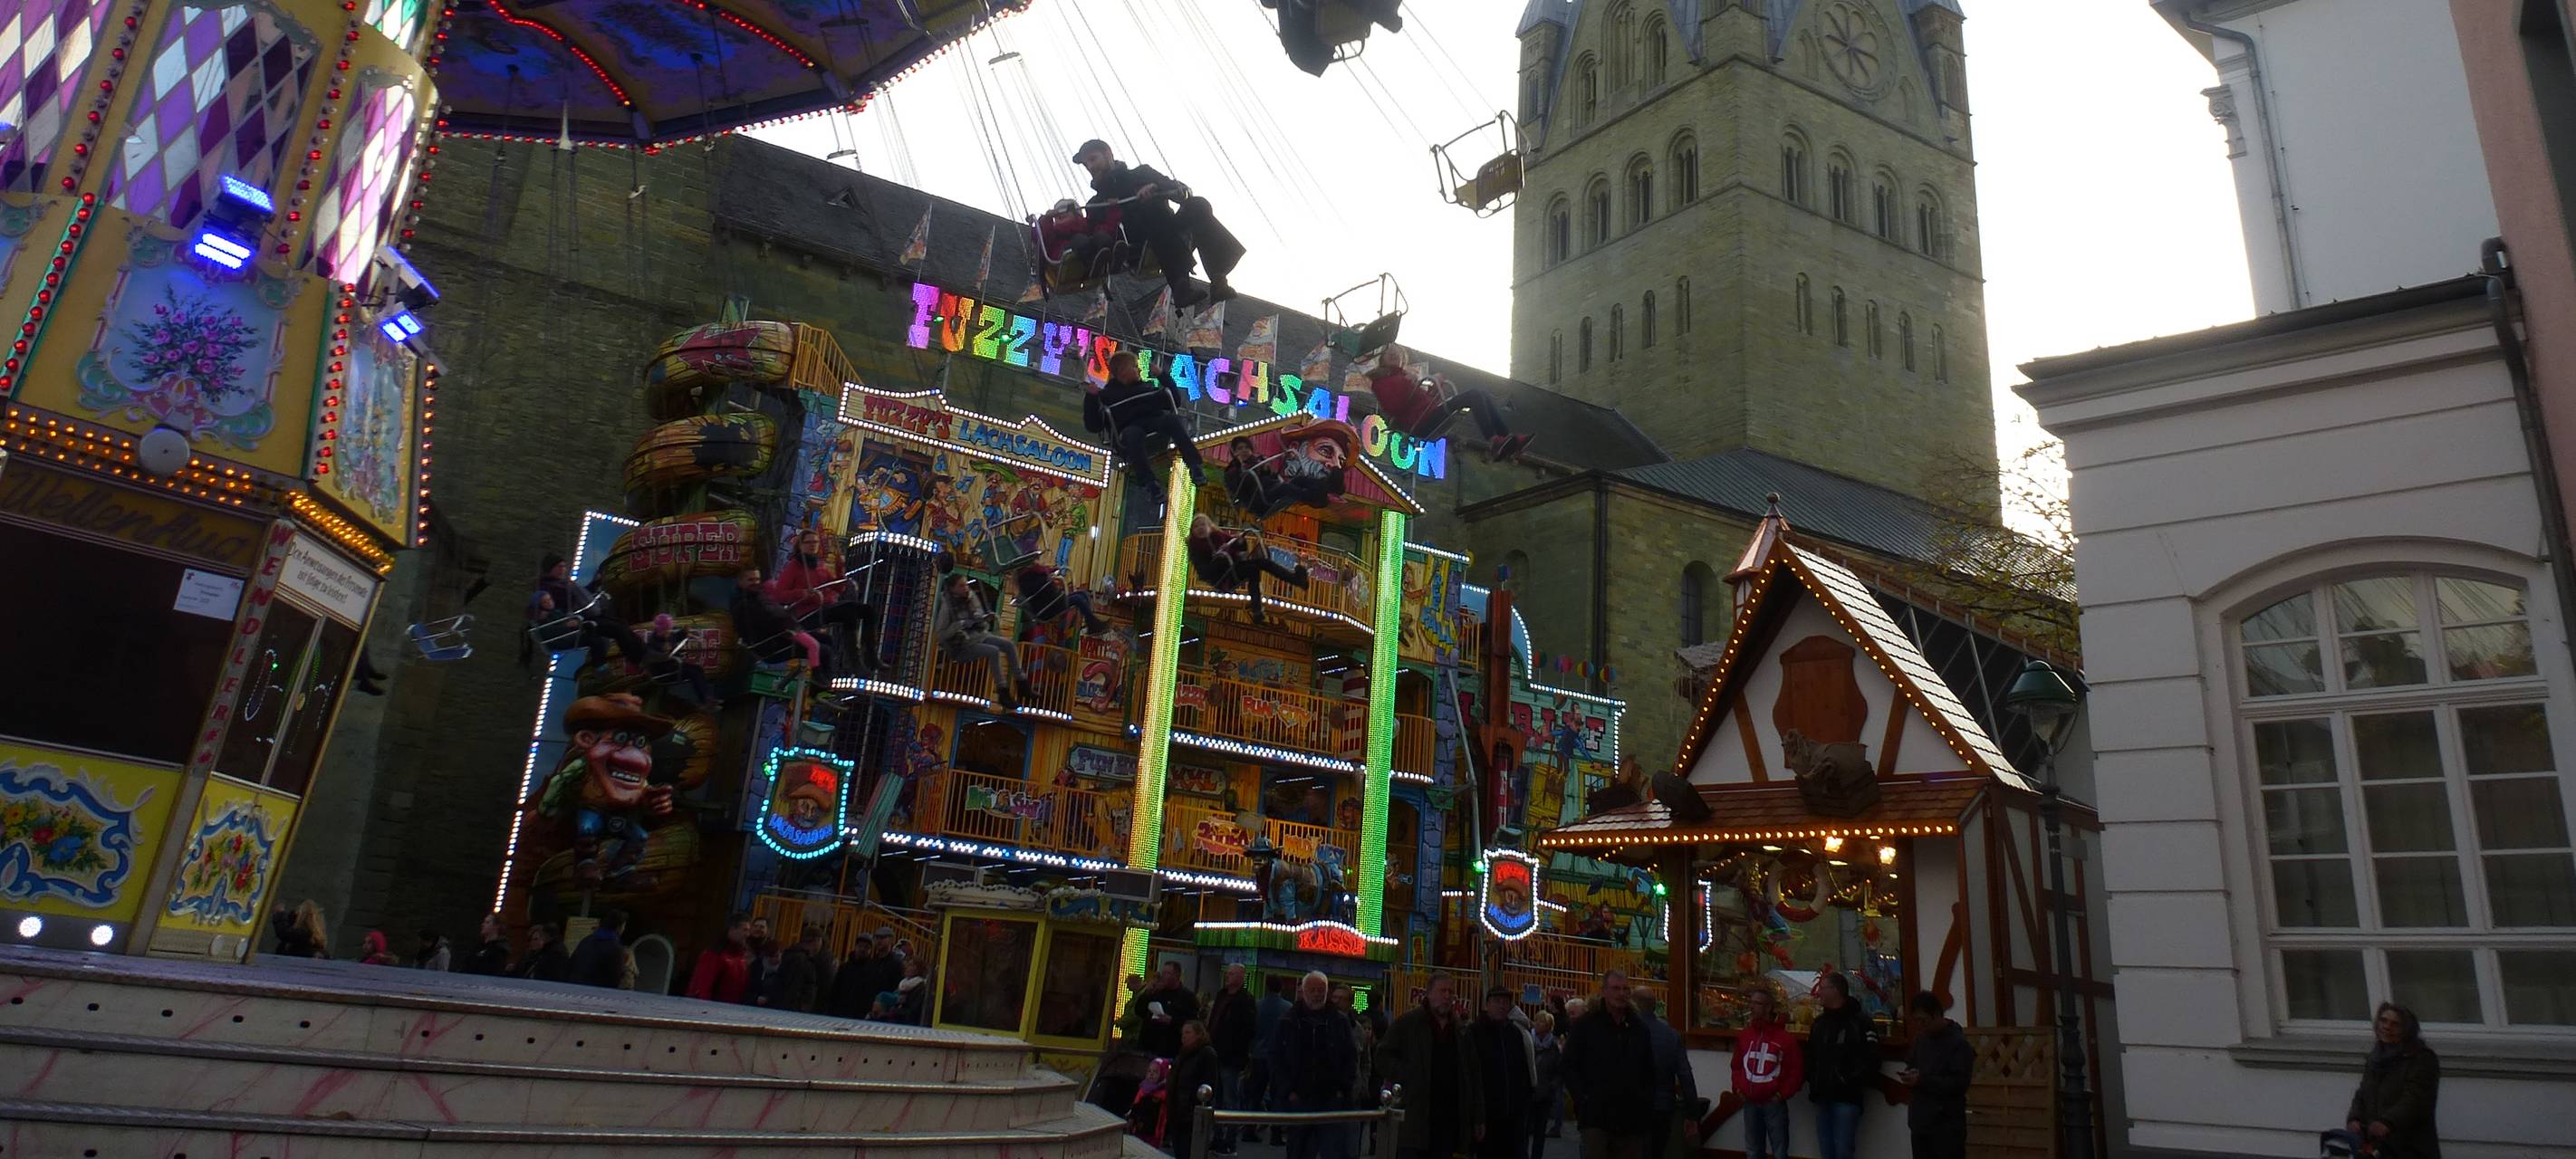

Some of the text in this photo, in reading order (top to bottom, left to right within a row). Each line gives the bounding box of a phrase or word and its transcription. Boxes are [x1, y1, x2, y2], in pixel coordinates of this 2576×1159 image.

[907, 282, 1118, 392] FUZZY'S
[863, 395, 1091, 473] FUZZY'S LACHSALOON
[630, 522, 740, 573] SUPER
[1297, 927, 1366, 957] KASSE
